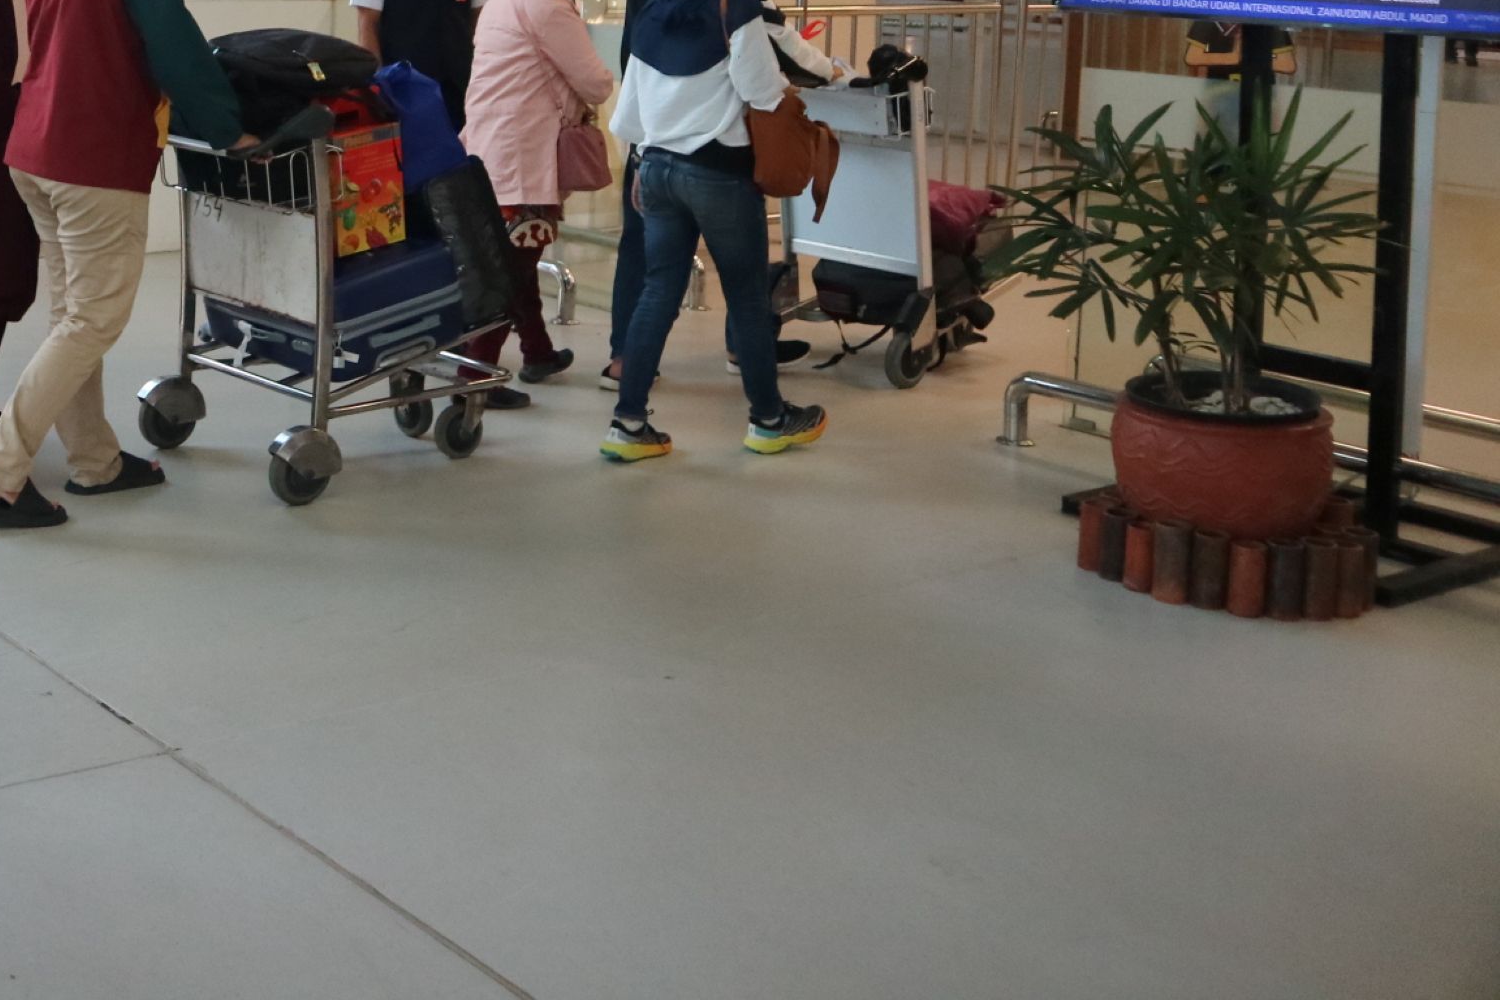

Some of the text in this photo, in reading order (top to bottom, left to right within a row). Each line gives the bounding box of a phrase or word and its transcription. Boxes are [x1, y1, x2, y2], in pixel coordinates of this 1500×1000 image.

[1210, 0, 1240, 10] UDARA
[1243, 1, 1316, 16] INTERNASIONAL
[1317, 7, 1371, 19] ZAINUDDIN
[1373, 10, 1408, 21] ABDUL
[1410, 12, 1448, 23] MADJID
